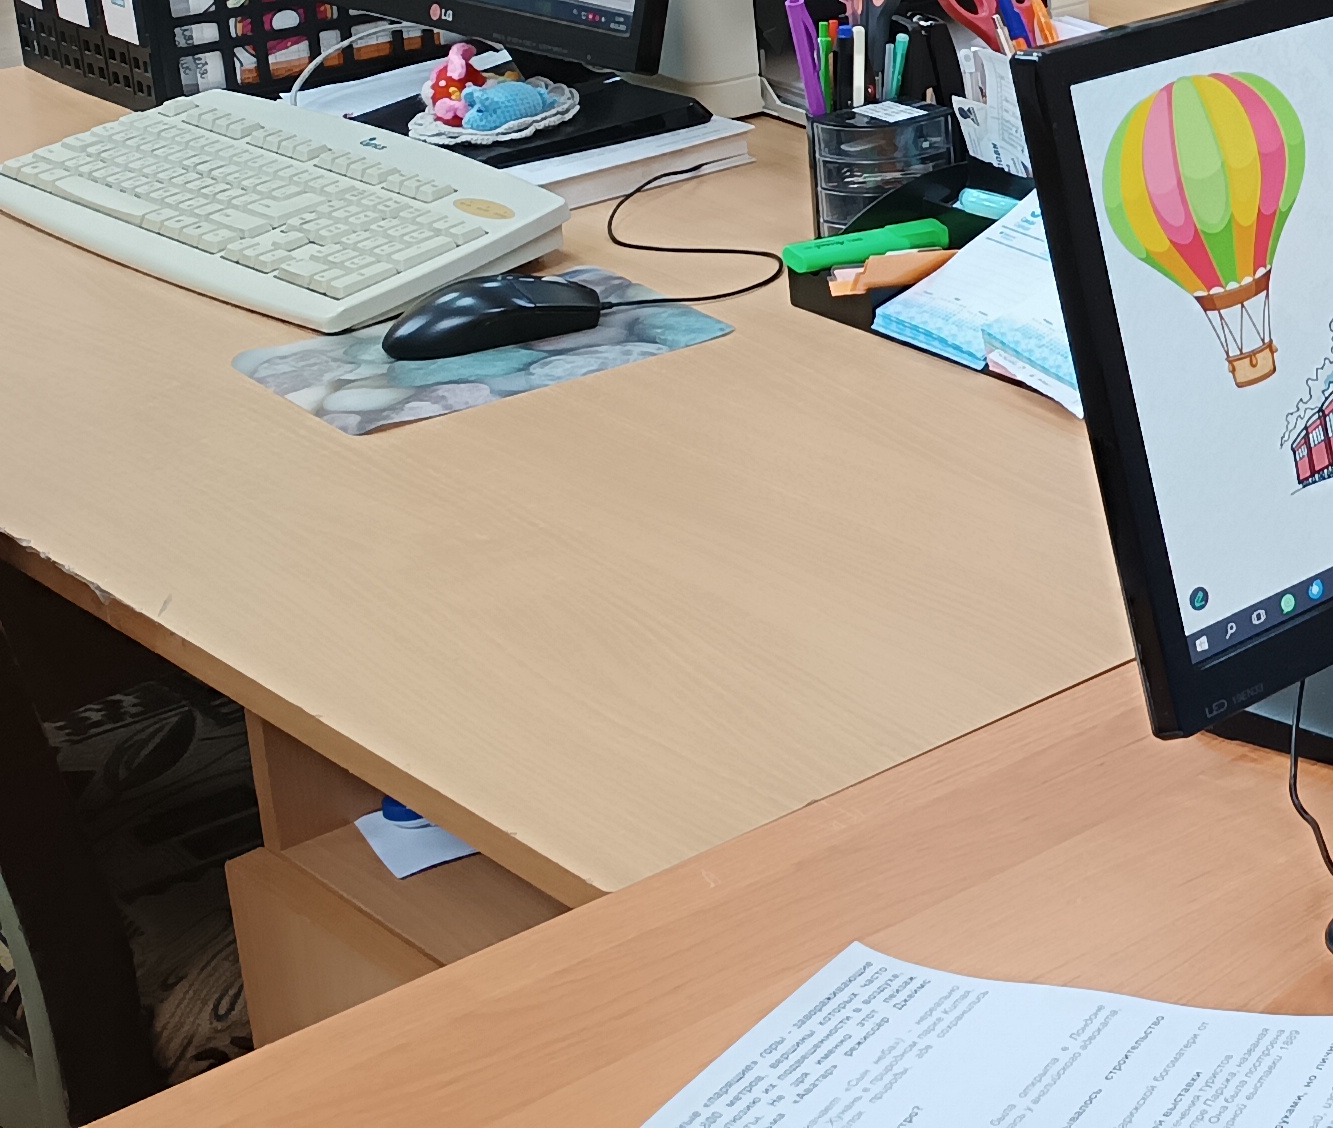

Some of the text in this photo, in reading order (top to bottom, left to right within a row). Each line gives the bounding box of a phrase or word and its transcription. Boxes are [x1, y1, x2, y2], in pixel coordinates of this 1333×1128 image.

[441, 7, 453, 22] LG
[1103, 1014, 1165, 1081] строительство
[1161, 1070, 1202, 1118] выставки
